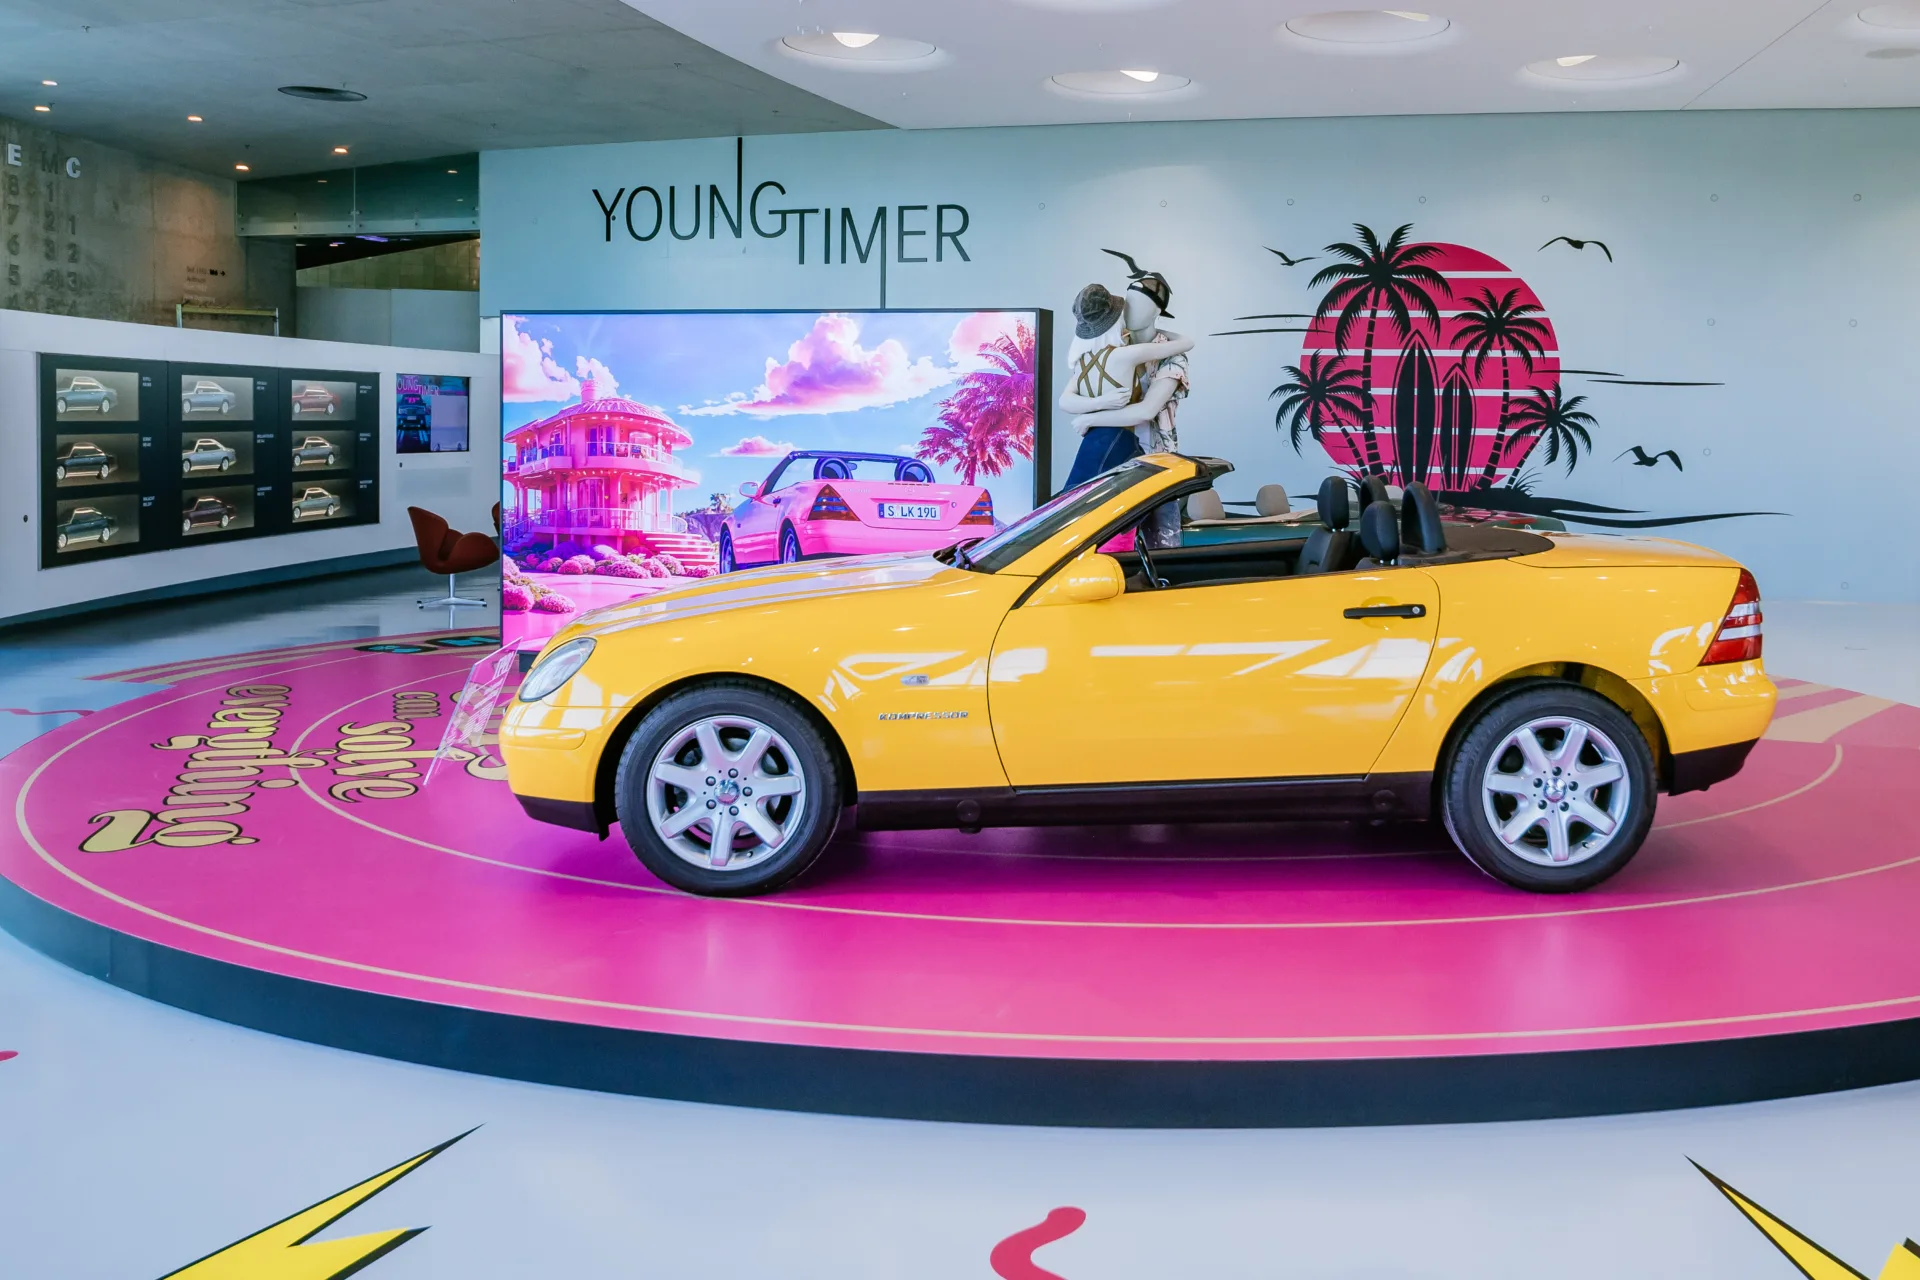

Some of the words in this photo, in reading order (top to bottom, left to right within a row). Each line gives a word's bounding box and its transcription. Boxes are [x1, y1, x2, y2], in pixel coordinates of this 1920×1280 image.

[7, 143, 22, 167] E
[66, 157, 81, 179] C
[69, 215, 76, 235] 1
[8, 234, 19, 256] 6
[68, 243, 80, 263] 2
[8, 264, 19, 285] 5
[888, 505, 894, 517] S
[901, 506, 914, 518] LK
[917, 507, 937, 518] 190
[392, 691, 441, 720] can
[878, 711, 969, 721] KOMPRESSOR
[78, 684, 339, 853] everything
[328, 721, 477, 802] solve
